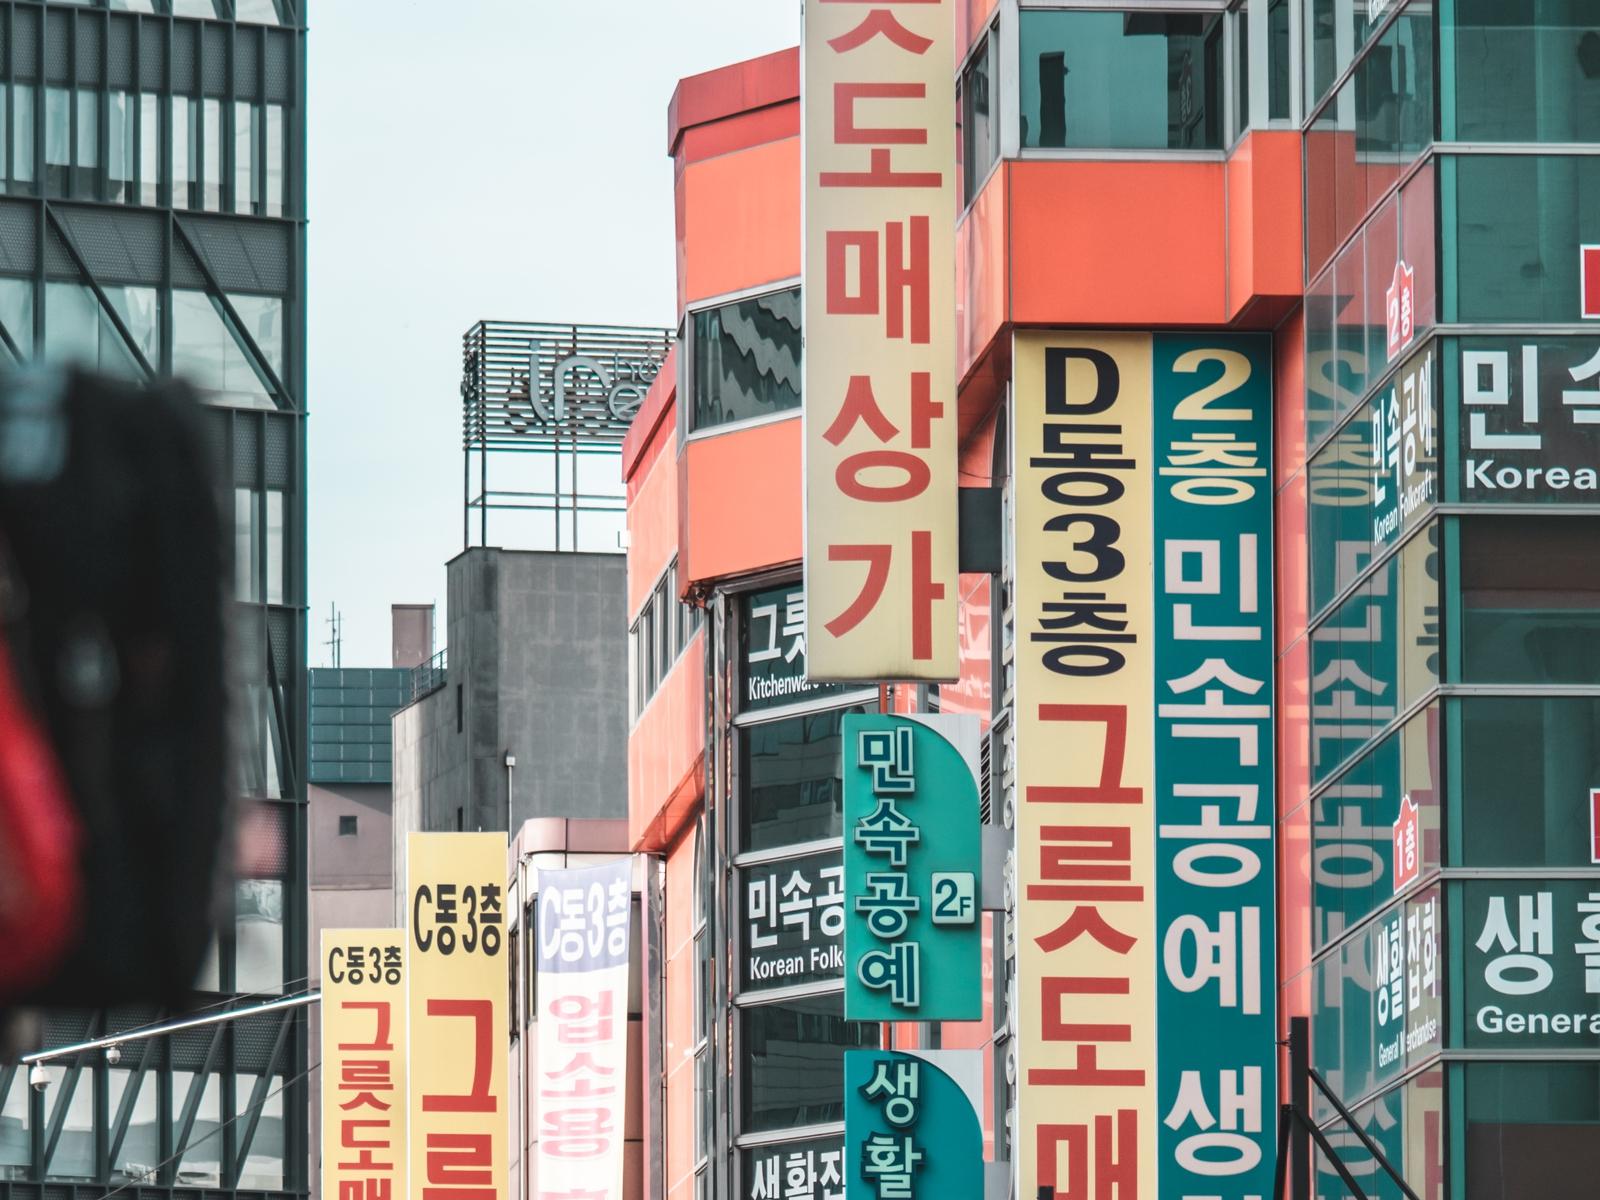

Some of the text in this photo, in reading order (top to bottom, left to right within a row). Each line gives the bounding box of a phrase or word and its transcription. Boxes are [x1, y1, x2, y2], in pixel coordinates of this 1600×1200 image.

[1389, 287, 1411, 346] 2층
[1159, 348, 1267, 506] 2층
[1372, 351, 1433, 507] 민속공예
[1030, 347, 1137, 676] D동3층
[1374, 470, 1433, 546] Korean Folkcraft
[749, 674, 820, 700] Kitchenwa
[1158, 533, 1272, 1015] 민속공예
[854, 726, 921, 1008] 민속공예
[1397, 820, 1416, 878] 1층
[414, 883, 502, 957] C동3층
[541, 878, 629, 963] C동3층
[749, 866, 845, 949] 민속공
[935, 878, 972, 918] 2F
[328, 945, 402, 985] C동3층
[750, 944, 846, 980] Korean Folk
[1376, 896, 1437, 1027] 생활잡화
[540, 989, 616, 1159] 업소용
[1378, 1033, 1399, 1068] General
